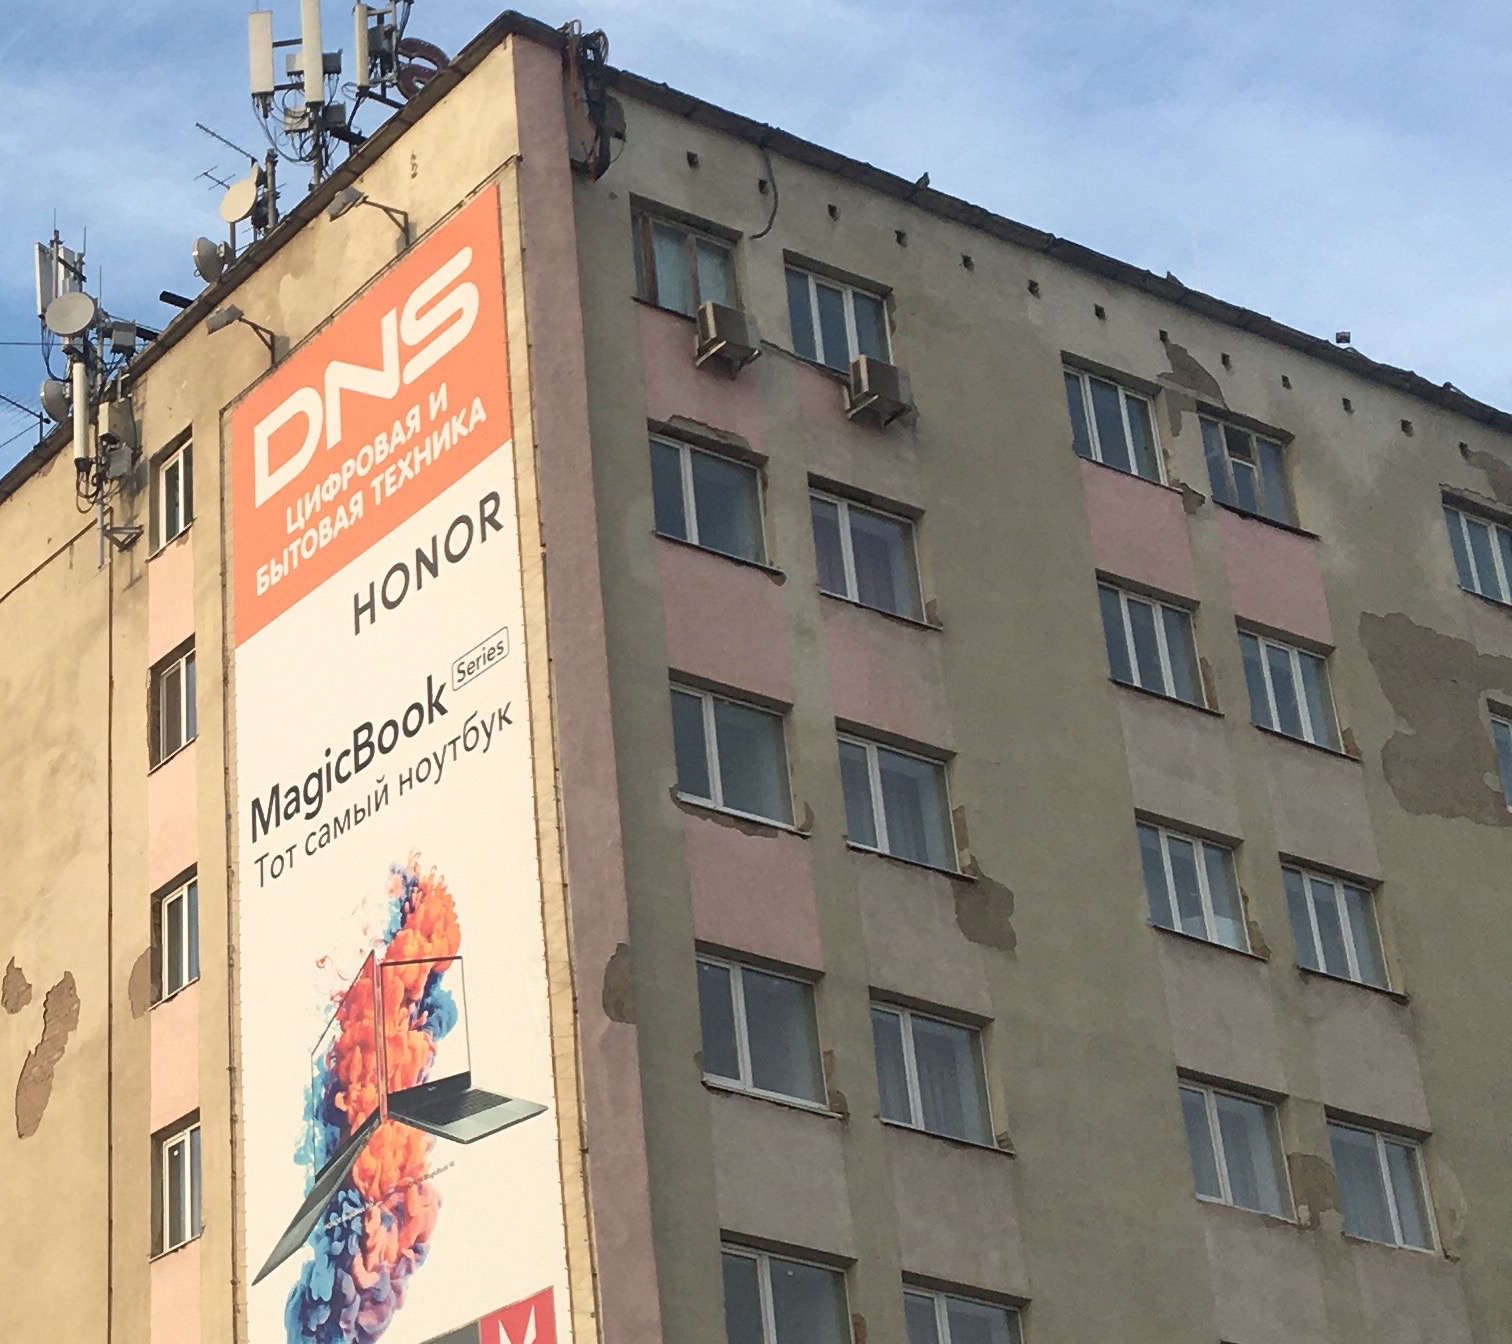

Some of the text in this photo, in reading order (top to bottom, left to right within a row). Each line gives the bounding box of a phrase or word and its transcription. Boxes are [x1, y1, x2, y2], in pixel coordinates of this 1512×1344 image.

[253, 246, 480, 509] DNS
[286, 382, 448, 535] ЦИФРОВАЯ И
[256, 396, 488, 597] БЫТОВАЯ ТЕХНИКА
[354, 490, 504, 636] HONOR
[251, 638, 505, 844] MagicBook Series
[254, 701, 513, 888] Тот самый ноутбук
